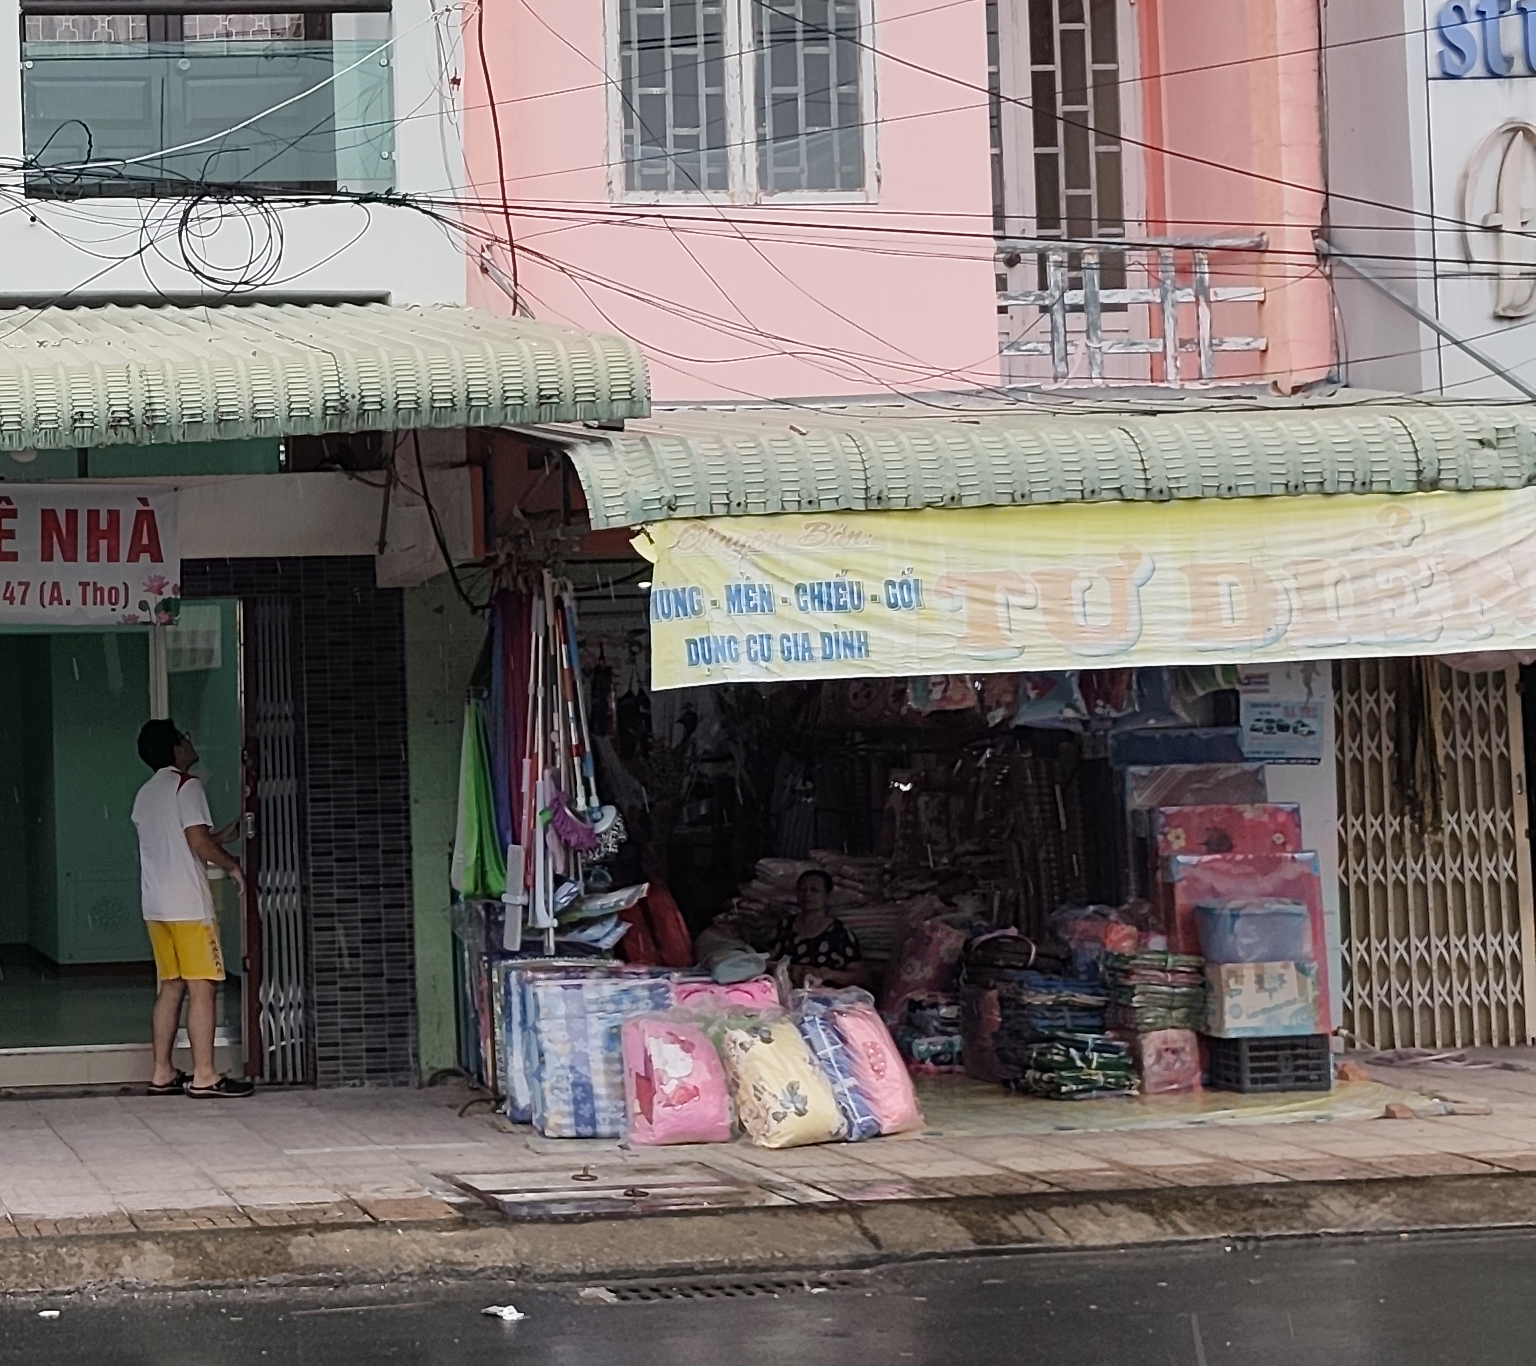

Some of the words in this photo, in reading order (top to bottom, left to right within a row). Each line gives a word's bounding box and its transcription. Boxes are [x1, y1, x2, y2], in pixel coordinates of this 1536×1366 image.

[40, 496, 164, 564] NHÀ
[2, 580, 31, 606] 47
[39, 581, 71, 609] (A.
[78, 581, 130, 612] Thọ)
[723, 571, 775, 615] MỀN
[779, 632, 814, 662] GIA
